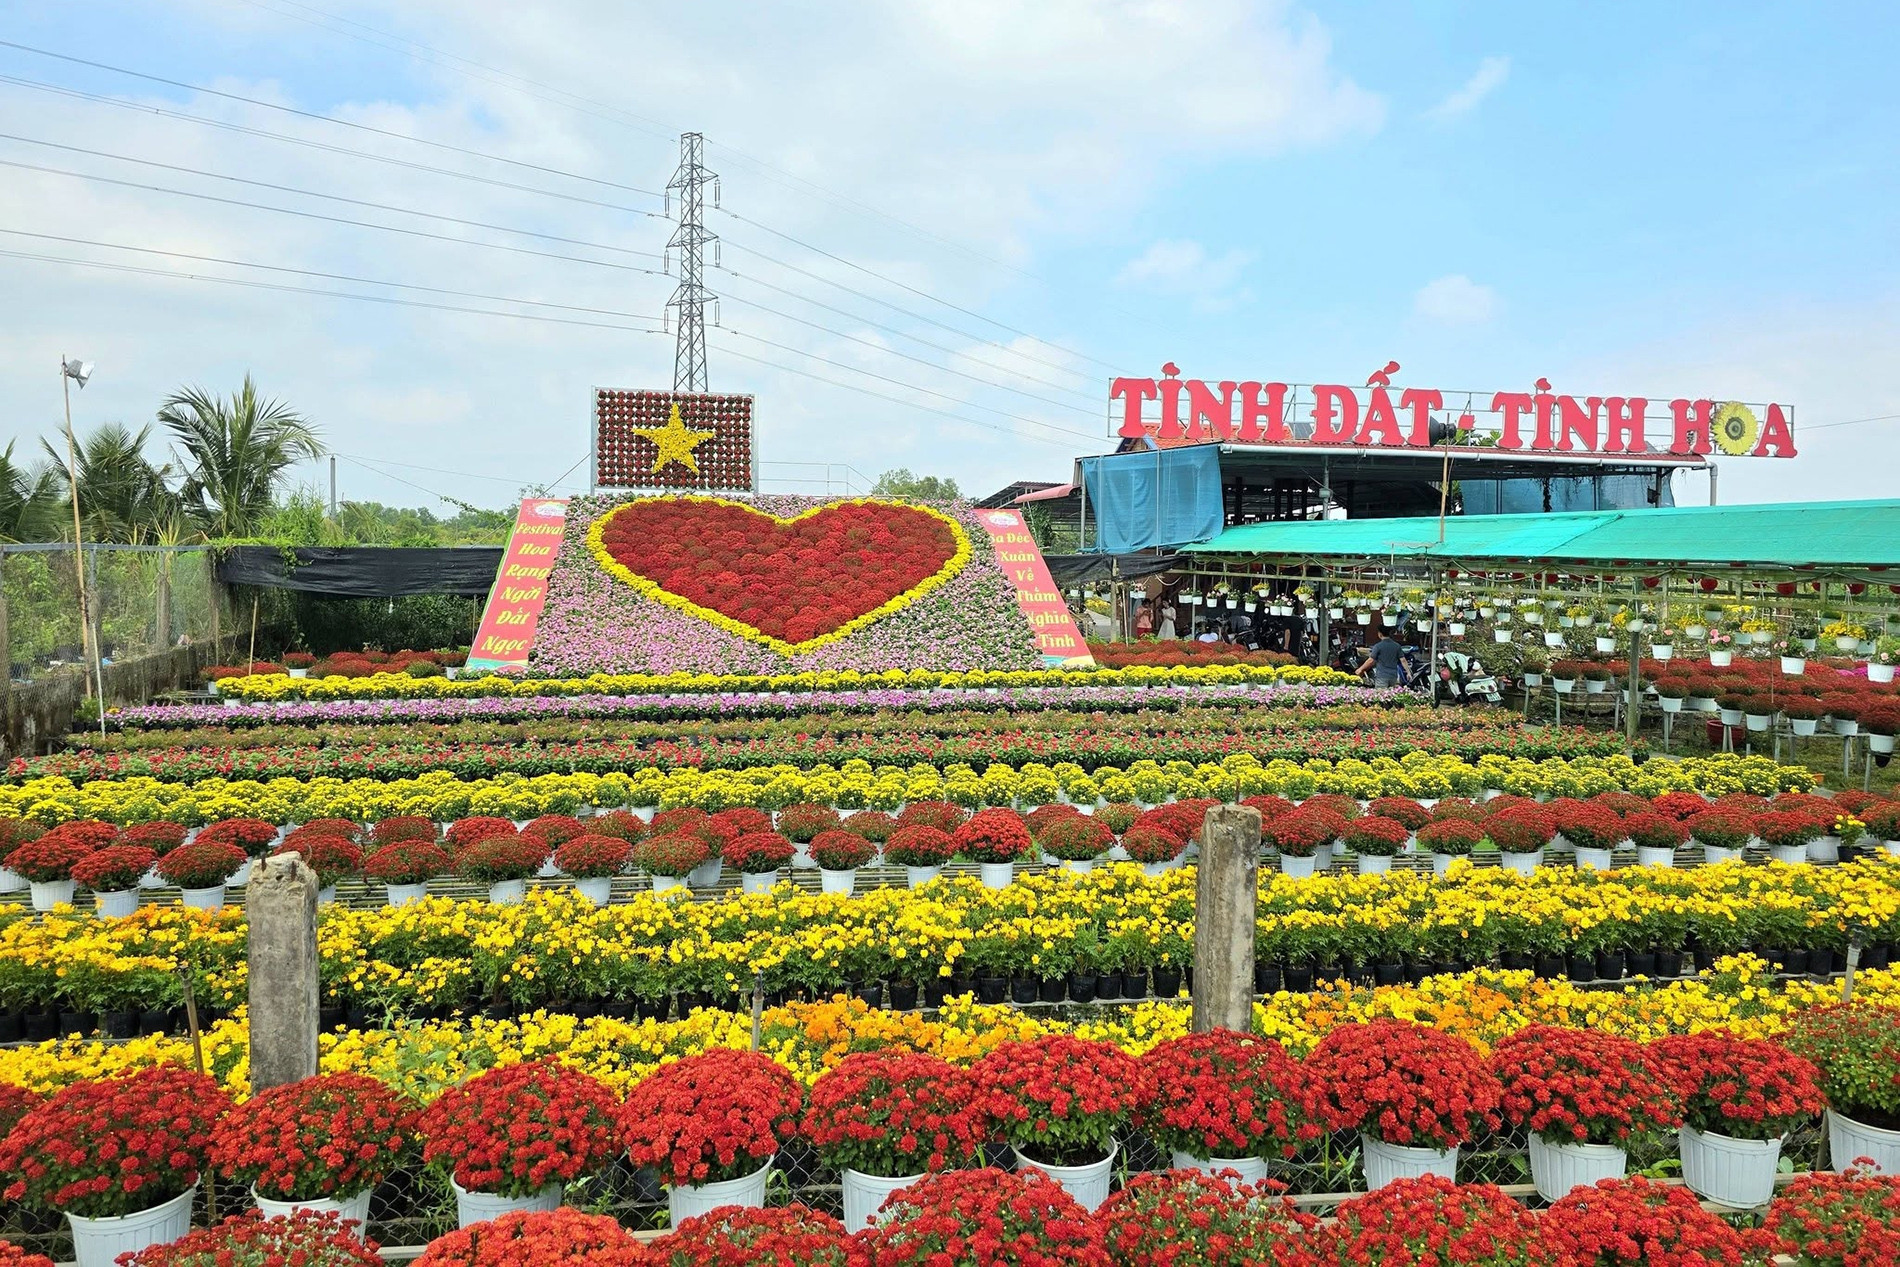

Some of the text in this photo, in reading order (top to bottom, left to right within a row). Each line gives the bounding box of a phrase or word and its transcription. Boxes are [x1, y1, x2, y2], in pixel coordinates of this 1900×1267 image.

[1310, 360, 1443, 447] ĐẤT
[515, 522, 564, 535] Festival
[518, 543, 551, 555] Hoa
[1000, 551, 1036, 562] Xuân
[505, 563, 550, 580] Rạng
[1015, 567, 1034, 581] Về
[495, 607, 531, 625] Đất
[481, 635, 528, 655] Ngọc
[1039, 633, 1075, 647] Tình
